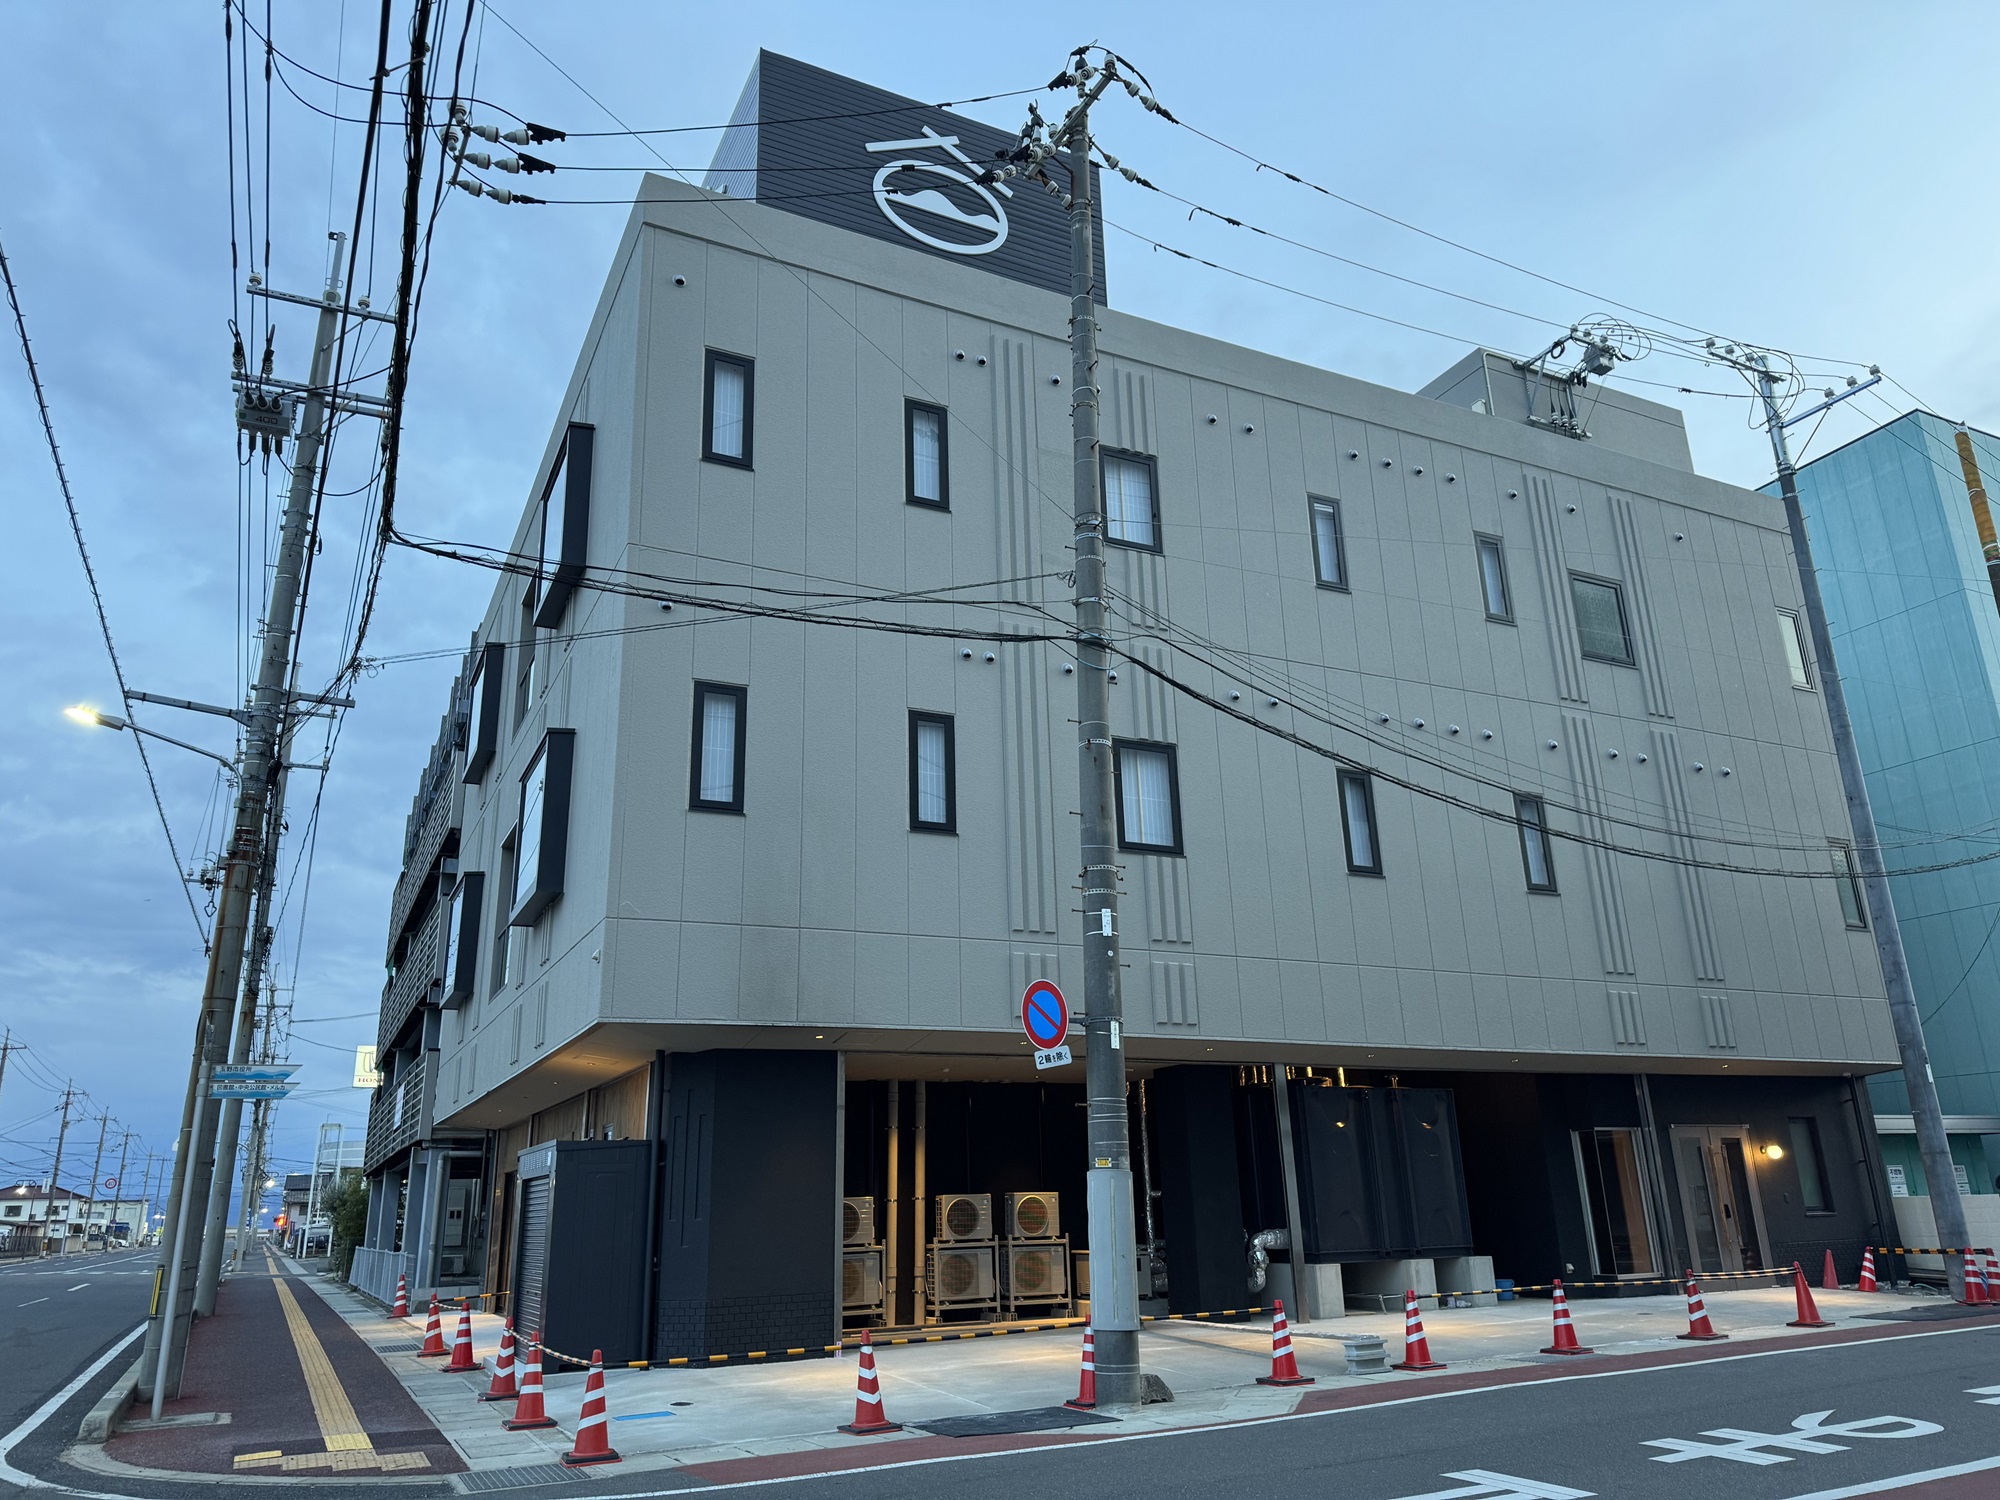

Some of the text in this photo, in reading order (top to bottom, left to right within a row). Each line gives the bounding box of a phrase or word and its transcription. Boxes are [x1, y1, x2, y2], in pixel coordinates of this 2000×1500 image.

[256, 416, 278, 424] 400
[1038, 1052, 1068, 1065] 2輪を除く
